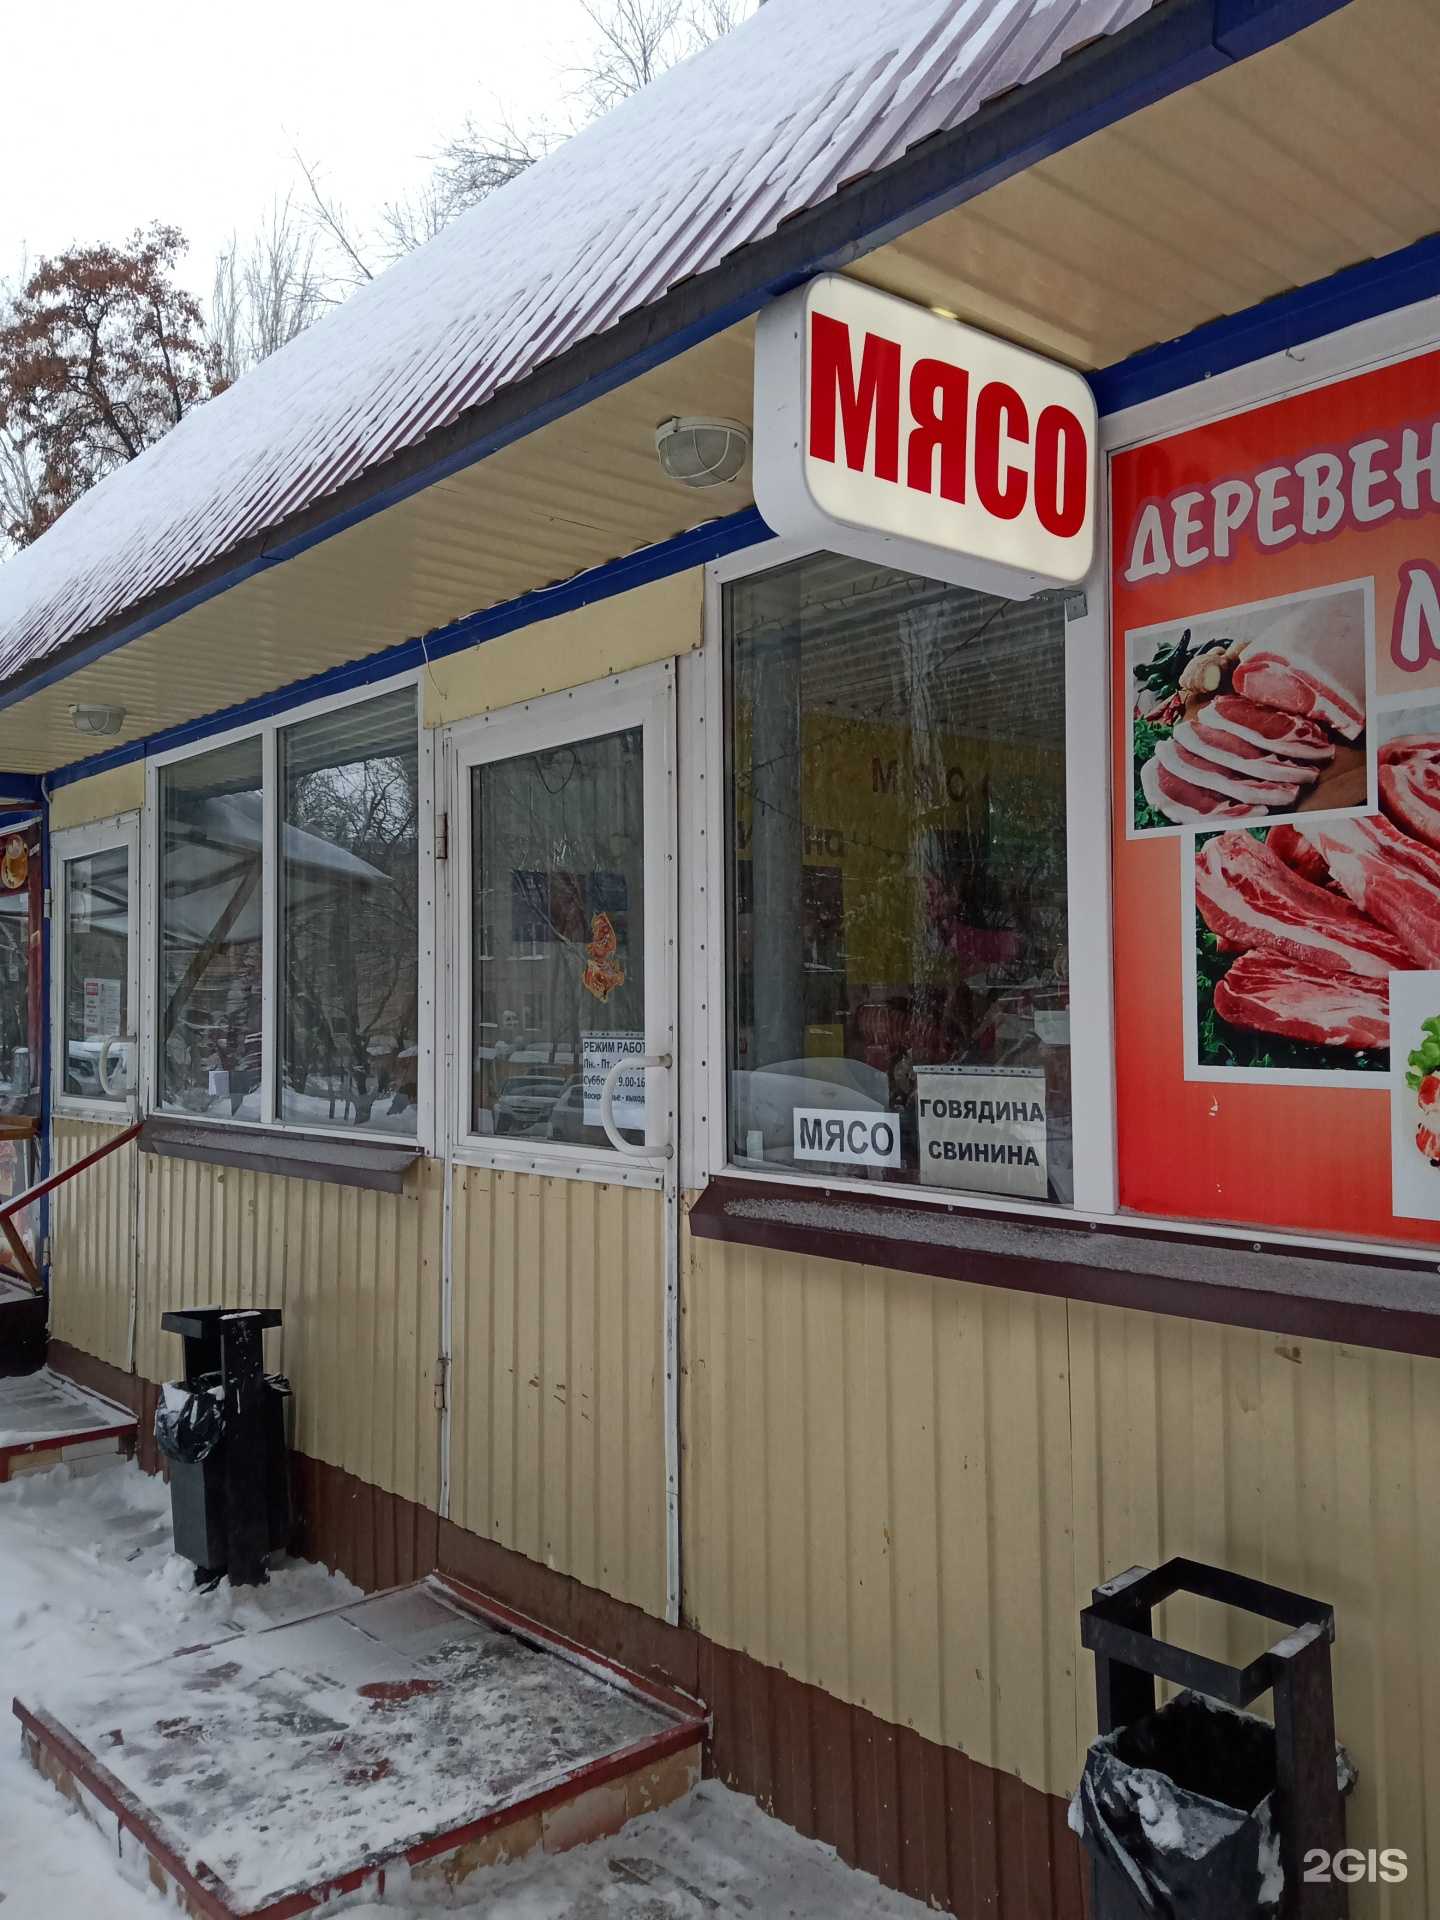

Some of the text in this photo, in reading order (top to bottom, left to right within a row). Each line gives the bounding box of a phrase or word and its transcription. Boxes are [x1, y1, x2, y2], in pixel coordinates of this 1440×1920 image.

[810, 310, 1088, 539] МЯСО
[583, 1041, 615, 1053] РЕЖИМ
[919, 1098, 1045, 1124] ГОВЯДИНА
[799, 1117, 894, 1156] МЯСО
[928, 1140, 1040, 1167] СВИНИНА
